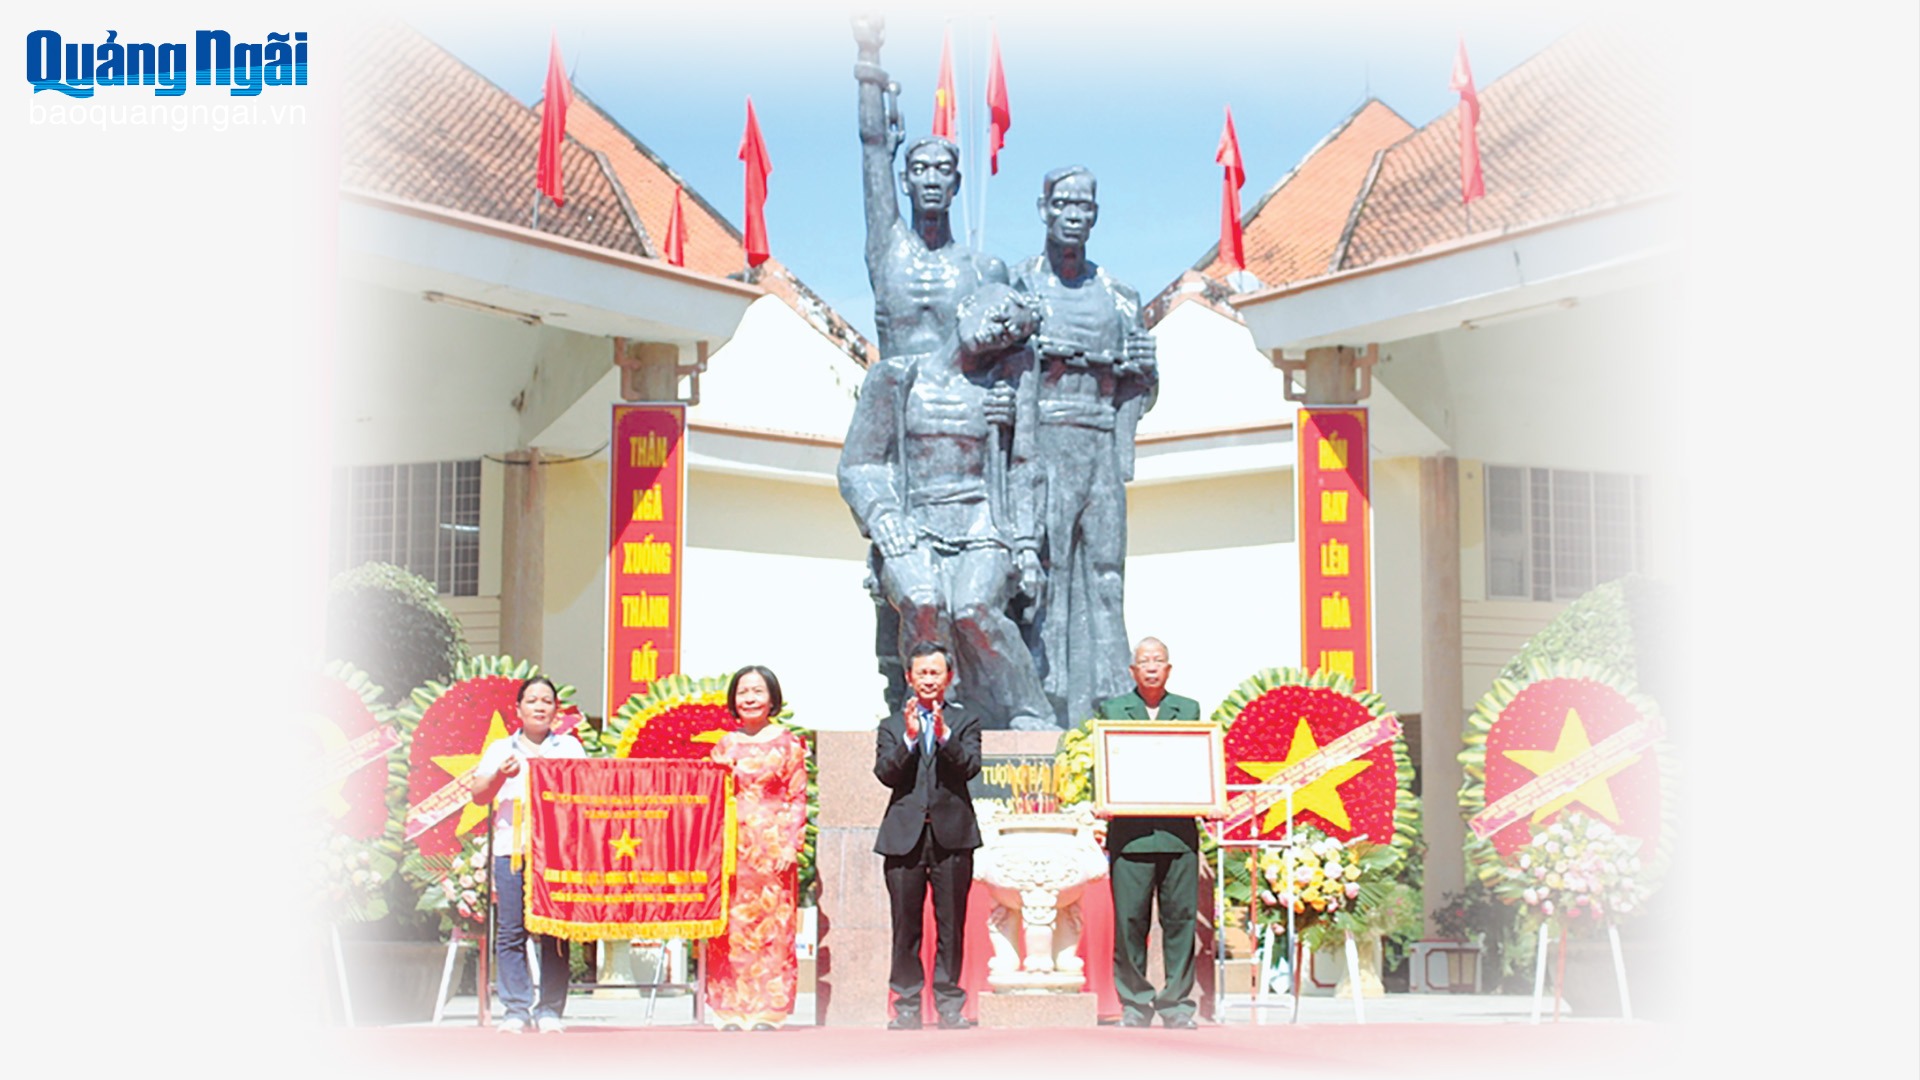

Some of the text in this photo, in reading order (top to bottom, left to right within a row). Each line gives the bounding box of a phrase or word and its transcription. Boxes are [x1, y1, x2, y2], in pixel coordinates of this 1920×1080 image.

[629, 430, 668, 468] THÂN
[632, 483, 664, 521] NGÃ
[622, 534, 671, 574] XUỐNG
[1320, 538, 1350, 577] LÊN
[621, 590, 670, 628] THÀNH
